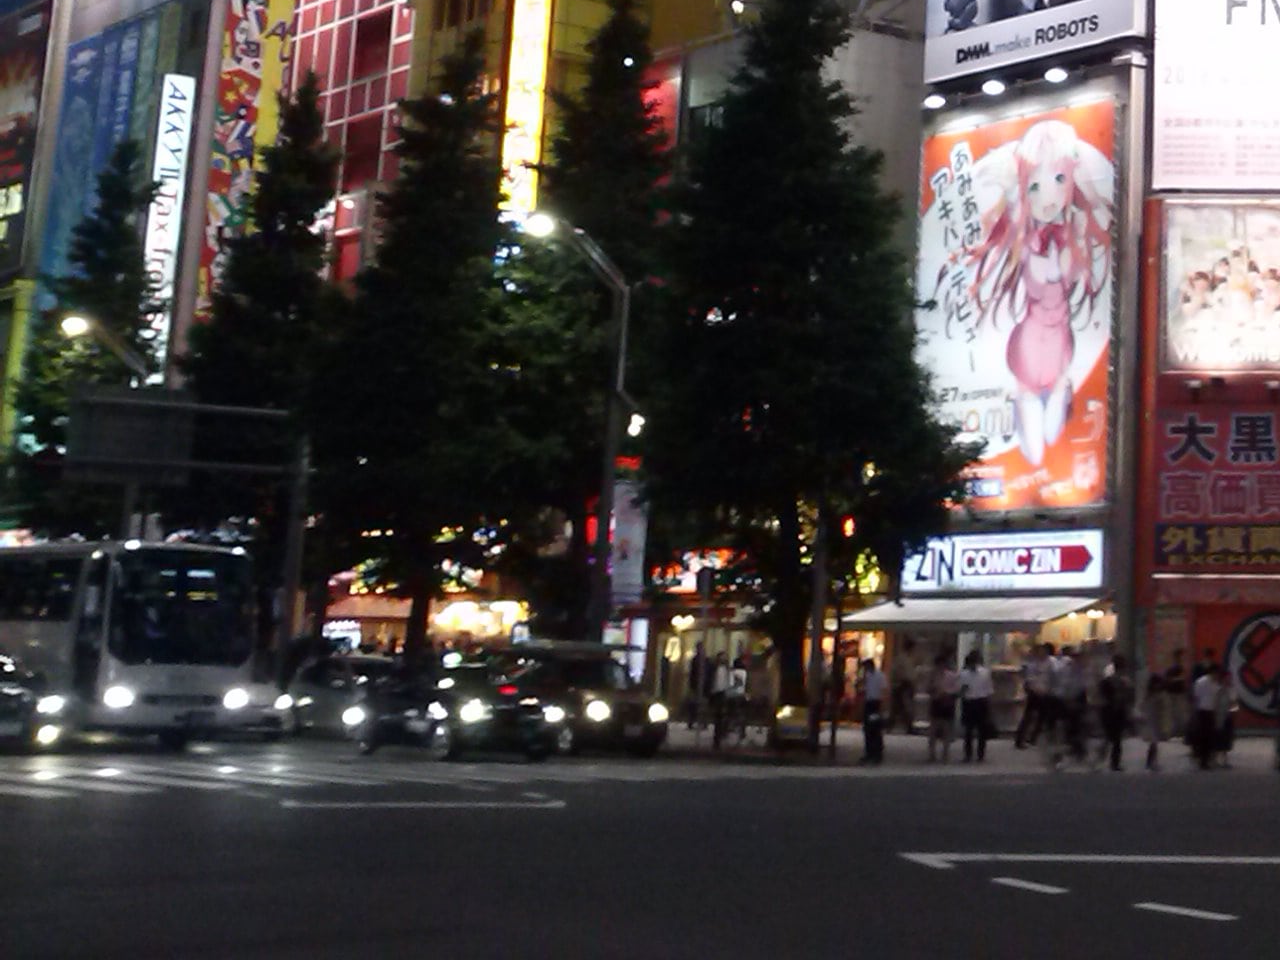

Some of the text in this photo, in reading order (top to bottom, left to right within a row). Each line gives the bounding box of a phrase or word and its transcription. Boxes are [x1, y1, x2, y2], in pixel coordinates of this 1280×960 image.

[1034, 14, 1099, 46] ROBOTS
[961, 547, 1061, 576] COMIC ZIN
